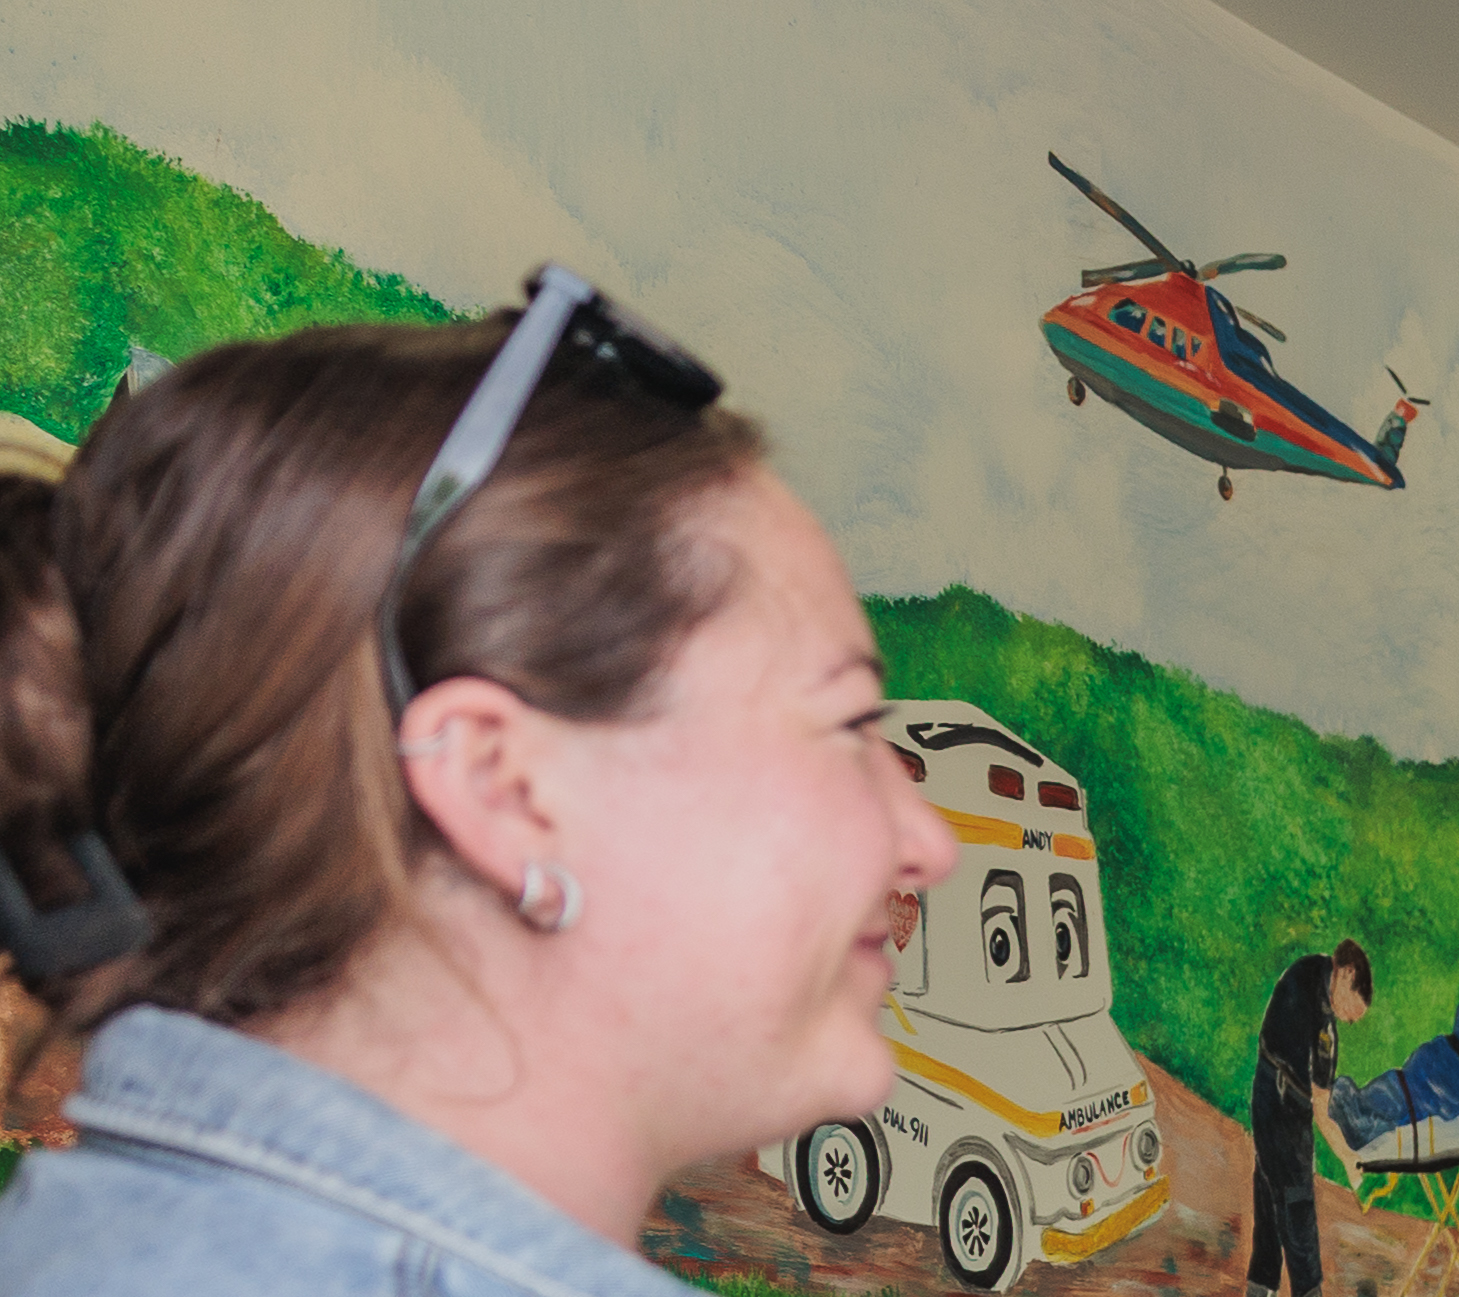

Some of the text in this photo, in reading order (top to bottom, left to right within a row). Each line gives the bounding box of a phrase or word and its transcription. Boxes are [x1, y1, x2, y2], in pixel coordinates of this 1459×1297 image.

[1022, 828, 1053, 851] ANDY
[883, 1106, 928, 1147] DIAL 911
[1059, 1090, 1131, 1132] AMBULANCE
